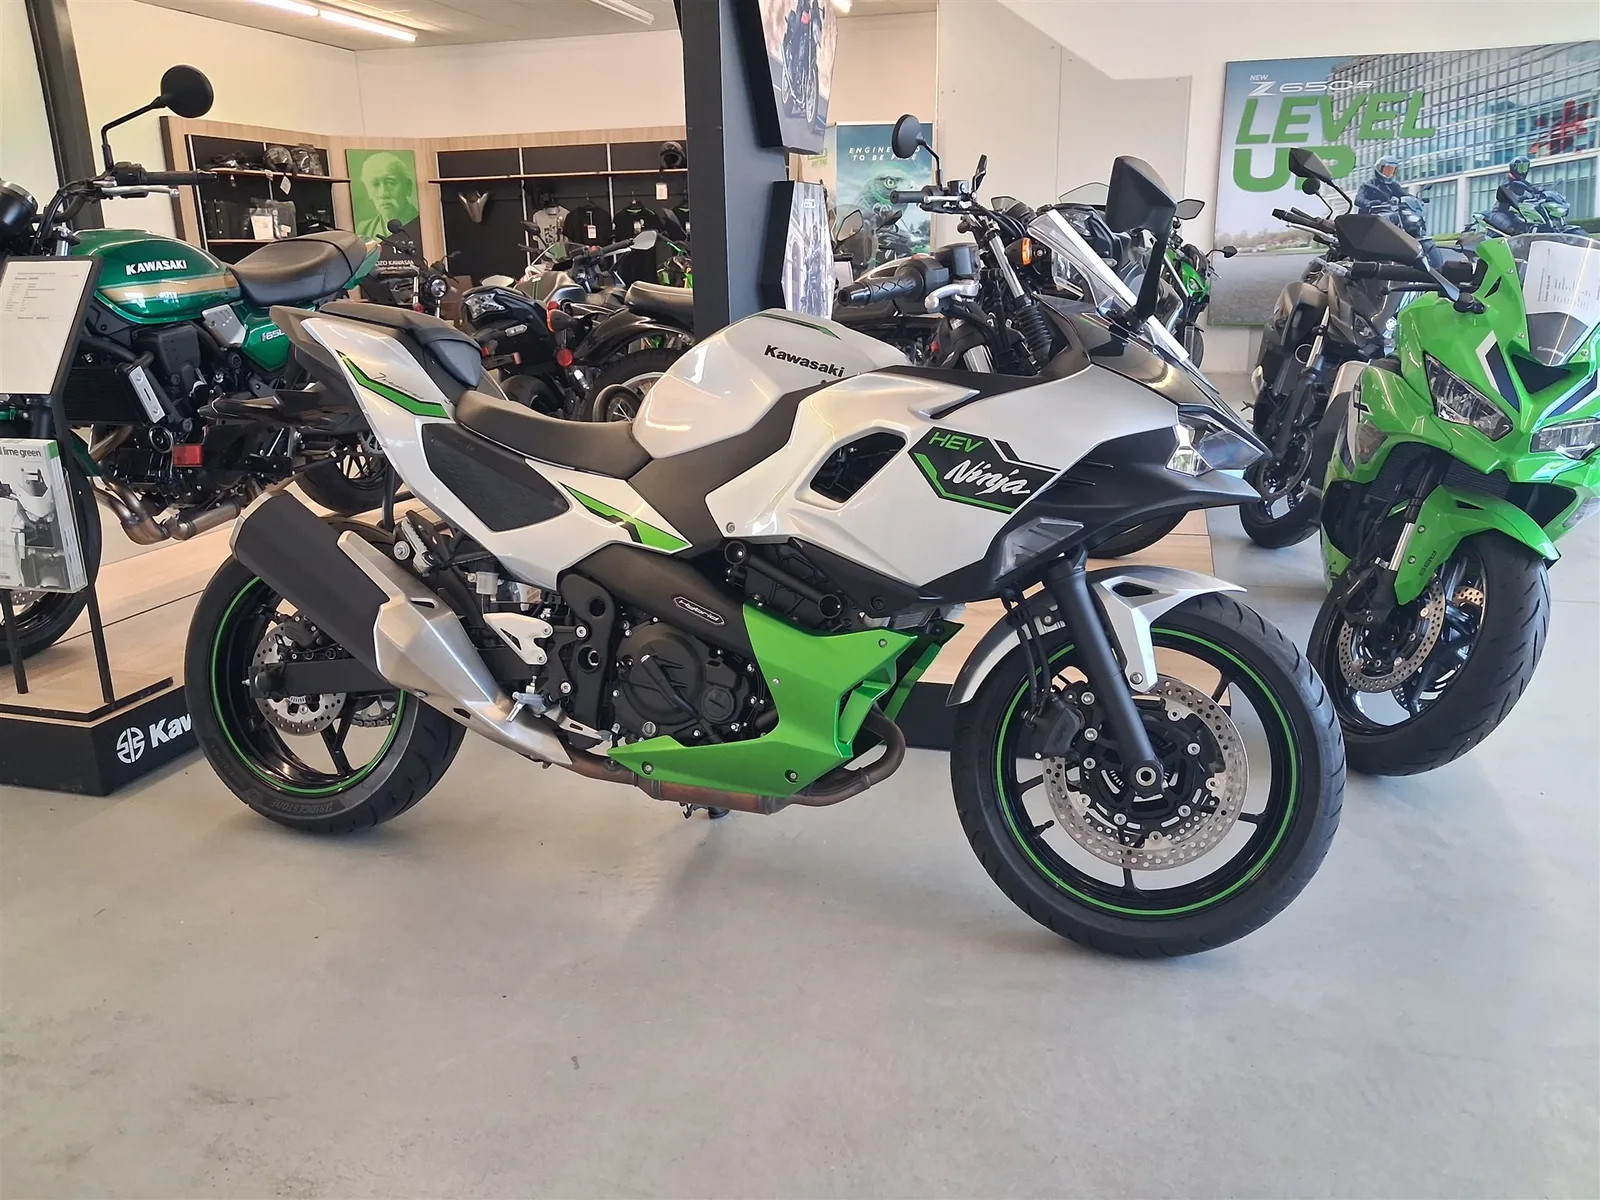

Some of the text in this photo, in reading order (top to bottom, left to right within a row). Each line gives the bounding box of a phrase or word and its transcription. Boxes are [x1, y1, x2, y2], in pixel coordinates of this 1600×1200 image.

[1235, 91, 1436, 145] LEVEL
[1232, 145, 1356, 193] UP
[125, 259, 188, 276] KAWASAKI
[763, 344, 846, 378] Kawasaki
[2, 446, 19, 457] lime
[19, 449, 42, 459] green
[928, 431, 984, 453] HEV
[943, 459, 1031, 496] Ninja
